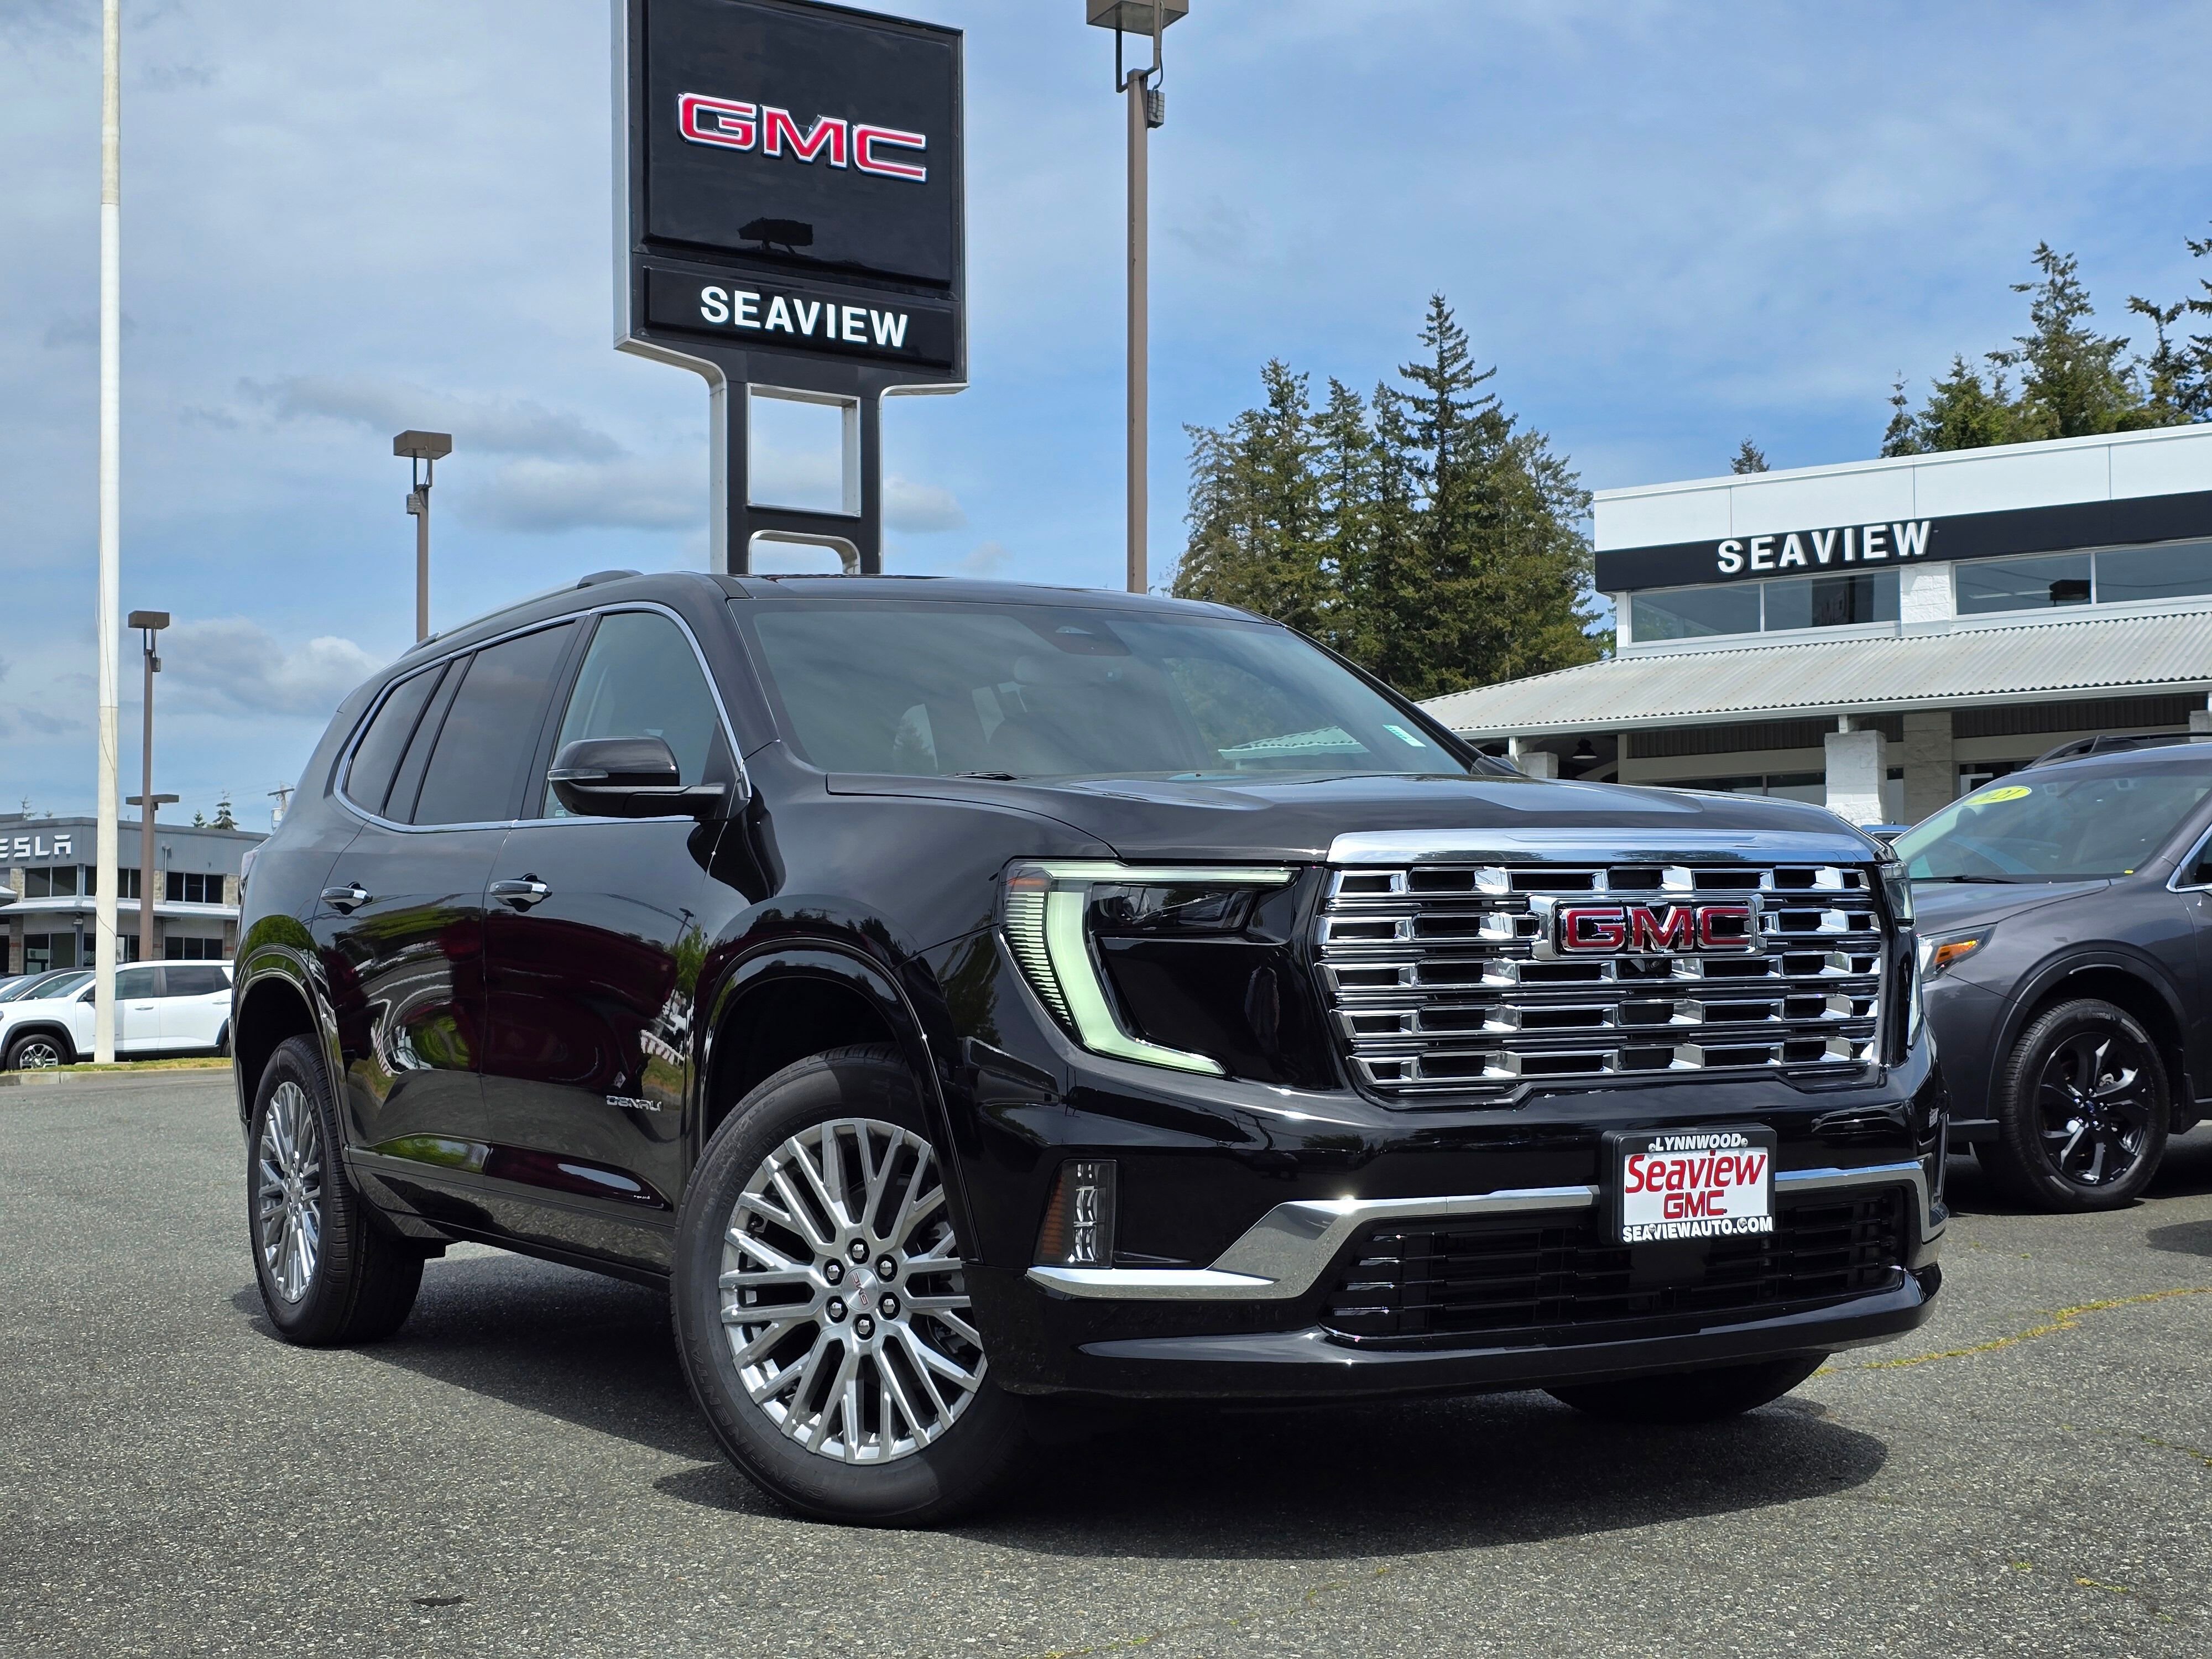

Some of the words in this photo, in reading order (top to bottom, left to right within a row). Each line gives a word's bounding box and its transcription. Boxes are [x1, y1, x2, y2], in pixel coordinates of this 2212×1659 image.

[678, 92, 927, 182] GMC
[700, 286, 909, 347] SEAVIEW
[1717, 520, 1932, 573] SEAVIEW
[1561, 905, 1752, 951] GMC
[606, 1095, 662, 1112] DENALI
[1655, 1133, 1742, 1151] LYNNWOOD
[1625, 1149, 1767, 1194] Seaview
[1663, 1189, 1728, 1220] GMC
[1623, 1216, 1773, 1243] SEAVIEWAUTO.COM
[852, 1271, 869, 1306] GMC
[686, 1321, 829, 1500] CONTINENTAL
